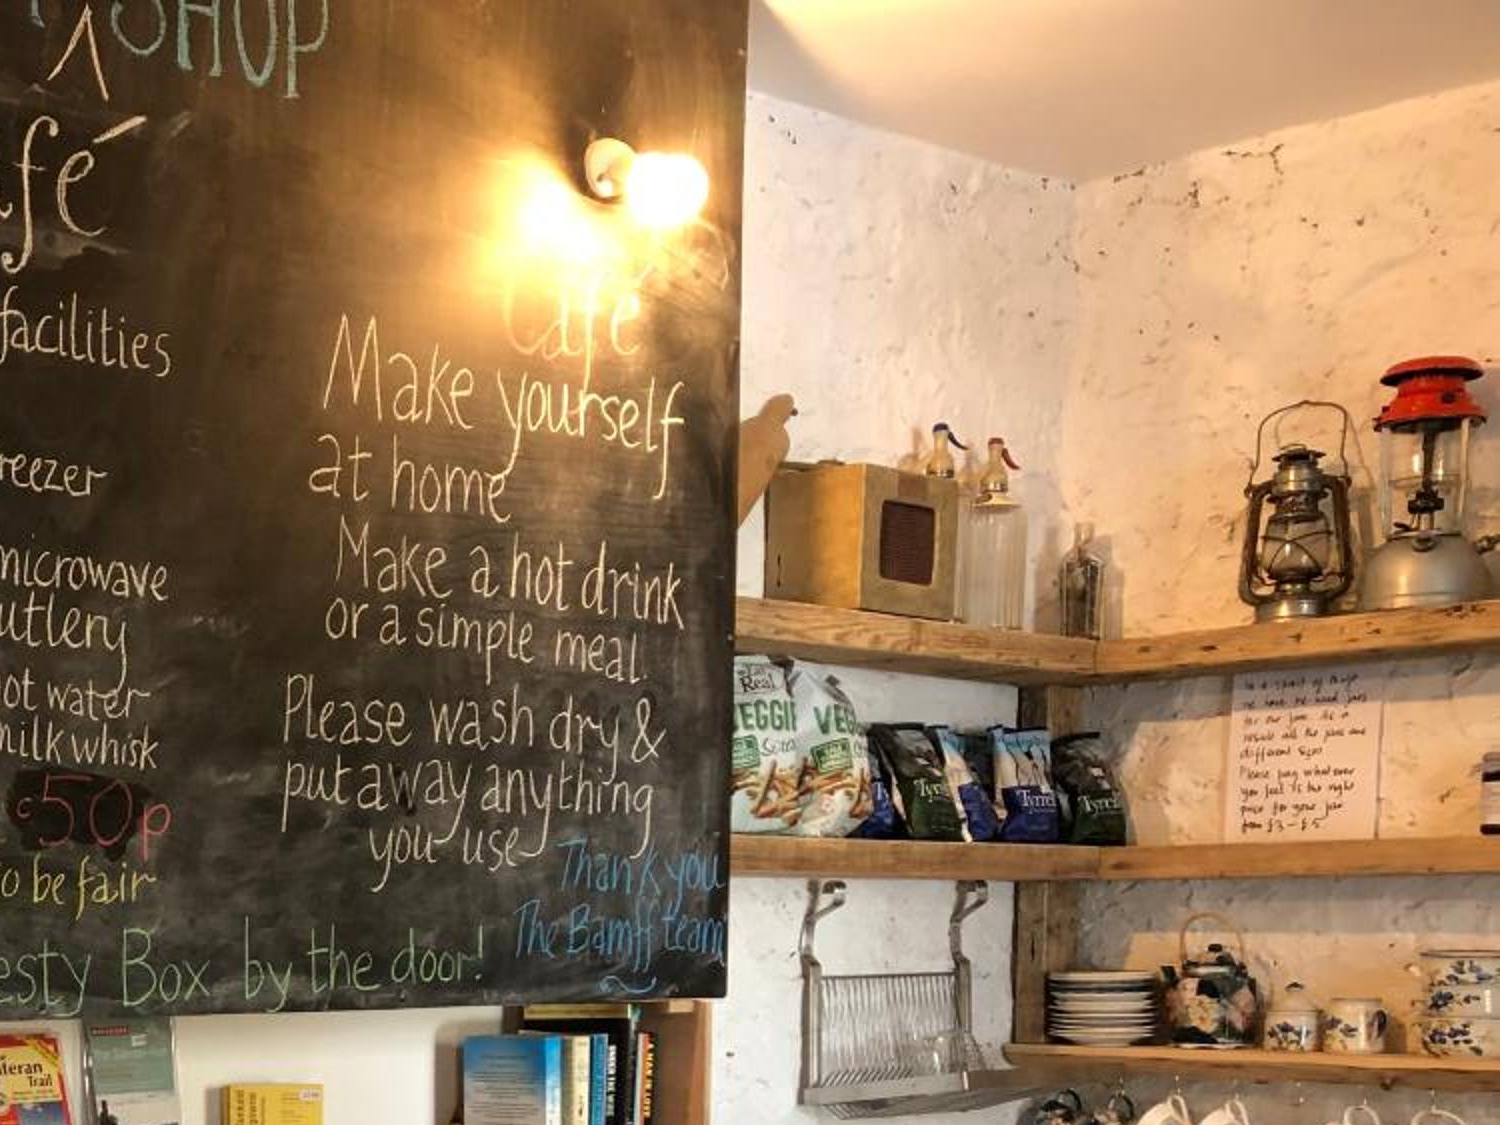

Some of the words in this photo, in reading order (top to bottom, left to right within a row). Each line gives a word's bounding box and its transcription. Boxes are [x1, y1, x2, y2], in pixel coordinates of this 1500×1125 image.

[322, 313, 476, 430] Make
[496, 366, 686, 500] yourself
[308, 433, 373, 502] at
[390, 433, 513, 525] home
[335, 513, 454, 600] Make
[468, 544, 500, 599] a
[510, 530, 576, 612] hot
[581, 539, 686, 632] drink
[325, 597, 370, 642] or
[378, 602, 410, 645] a
[414, 602, 535, 687] simple
[46, 680, 152, 723] water
[283, 672, 414, 747] Please
[430, 683, 535, 752] wash
[549, 695, 621, 786] dry
[630, 697, 668, 768] &
[733, 699, 797, 732] EGGI
[71, 722, 159, 772] whisk
[282, 756, 357, 833] put
[357, 760, 476, 846] away
[480, 760, 656, 860] anything
[33, 851, 67, 906] be
[76, 854, 158, 922] fair
[368, 822, 440, 894] you
[462, 824, 522, 874] use
[553, 836, 660, 898] Thank
[668, 850, 725, 918] you
[120, 926, 213, 1010] Box
[244, 914, 295, 1014] by
[306, 920, 382, 994] the
[390, 922, 486, 984] door!
[514, 899, 558, 960] The
[27, 1073, 54, 1088] Trail
